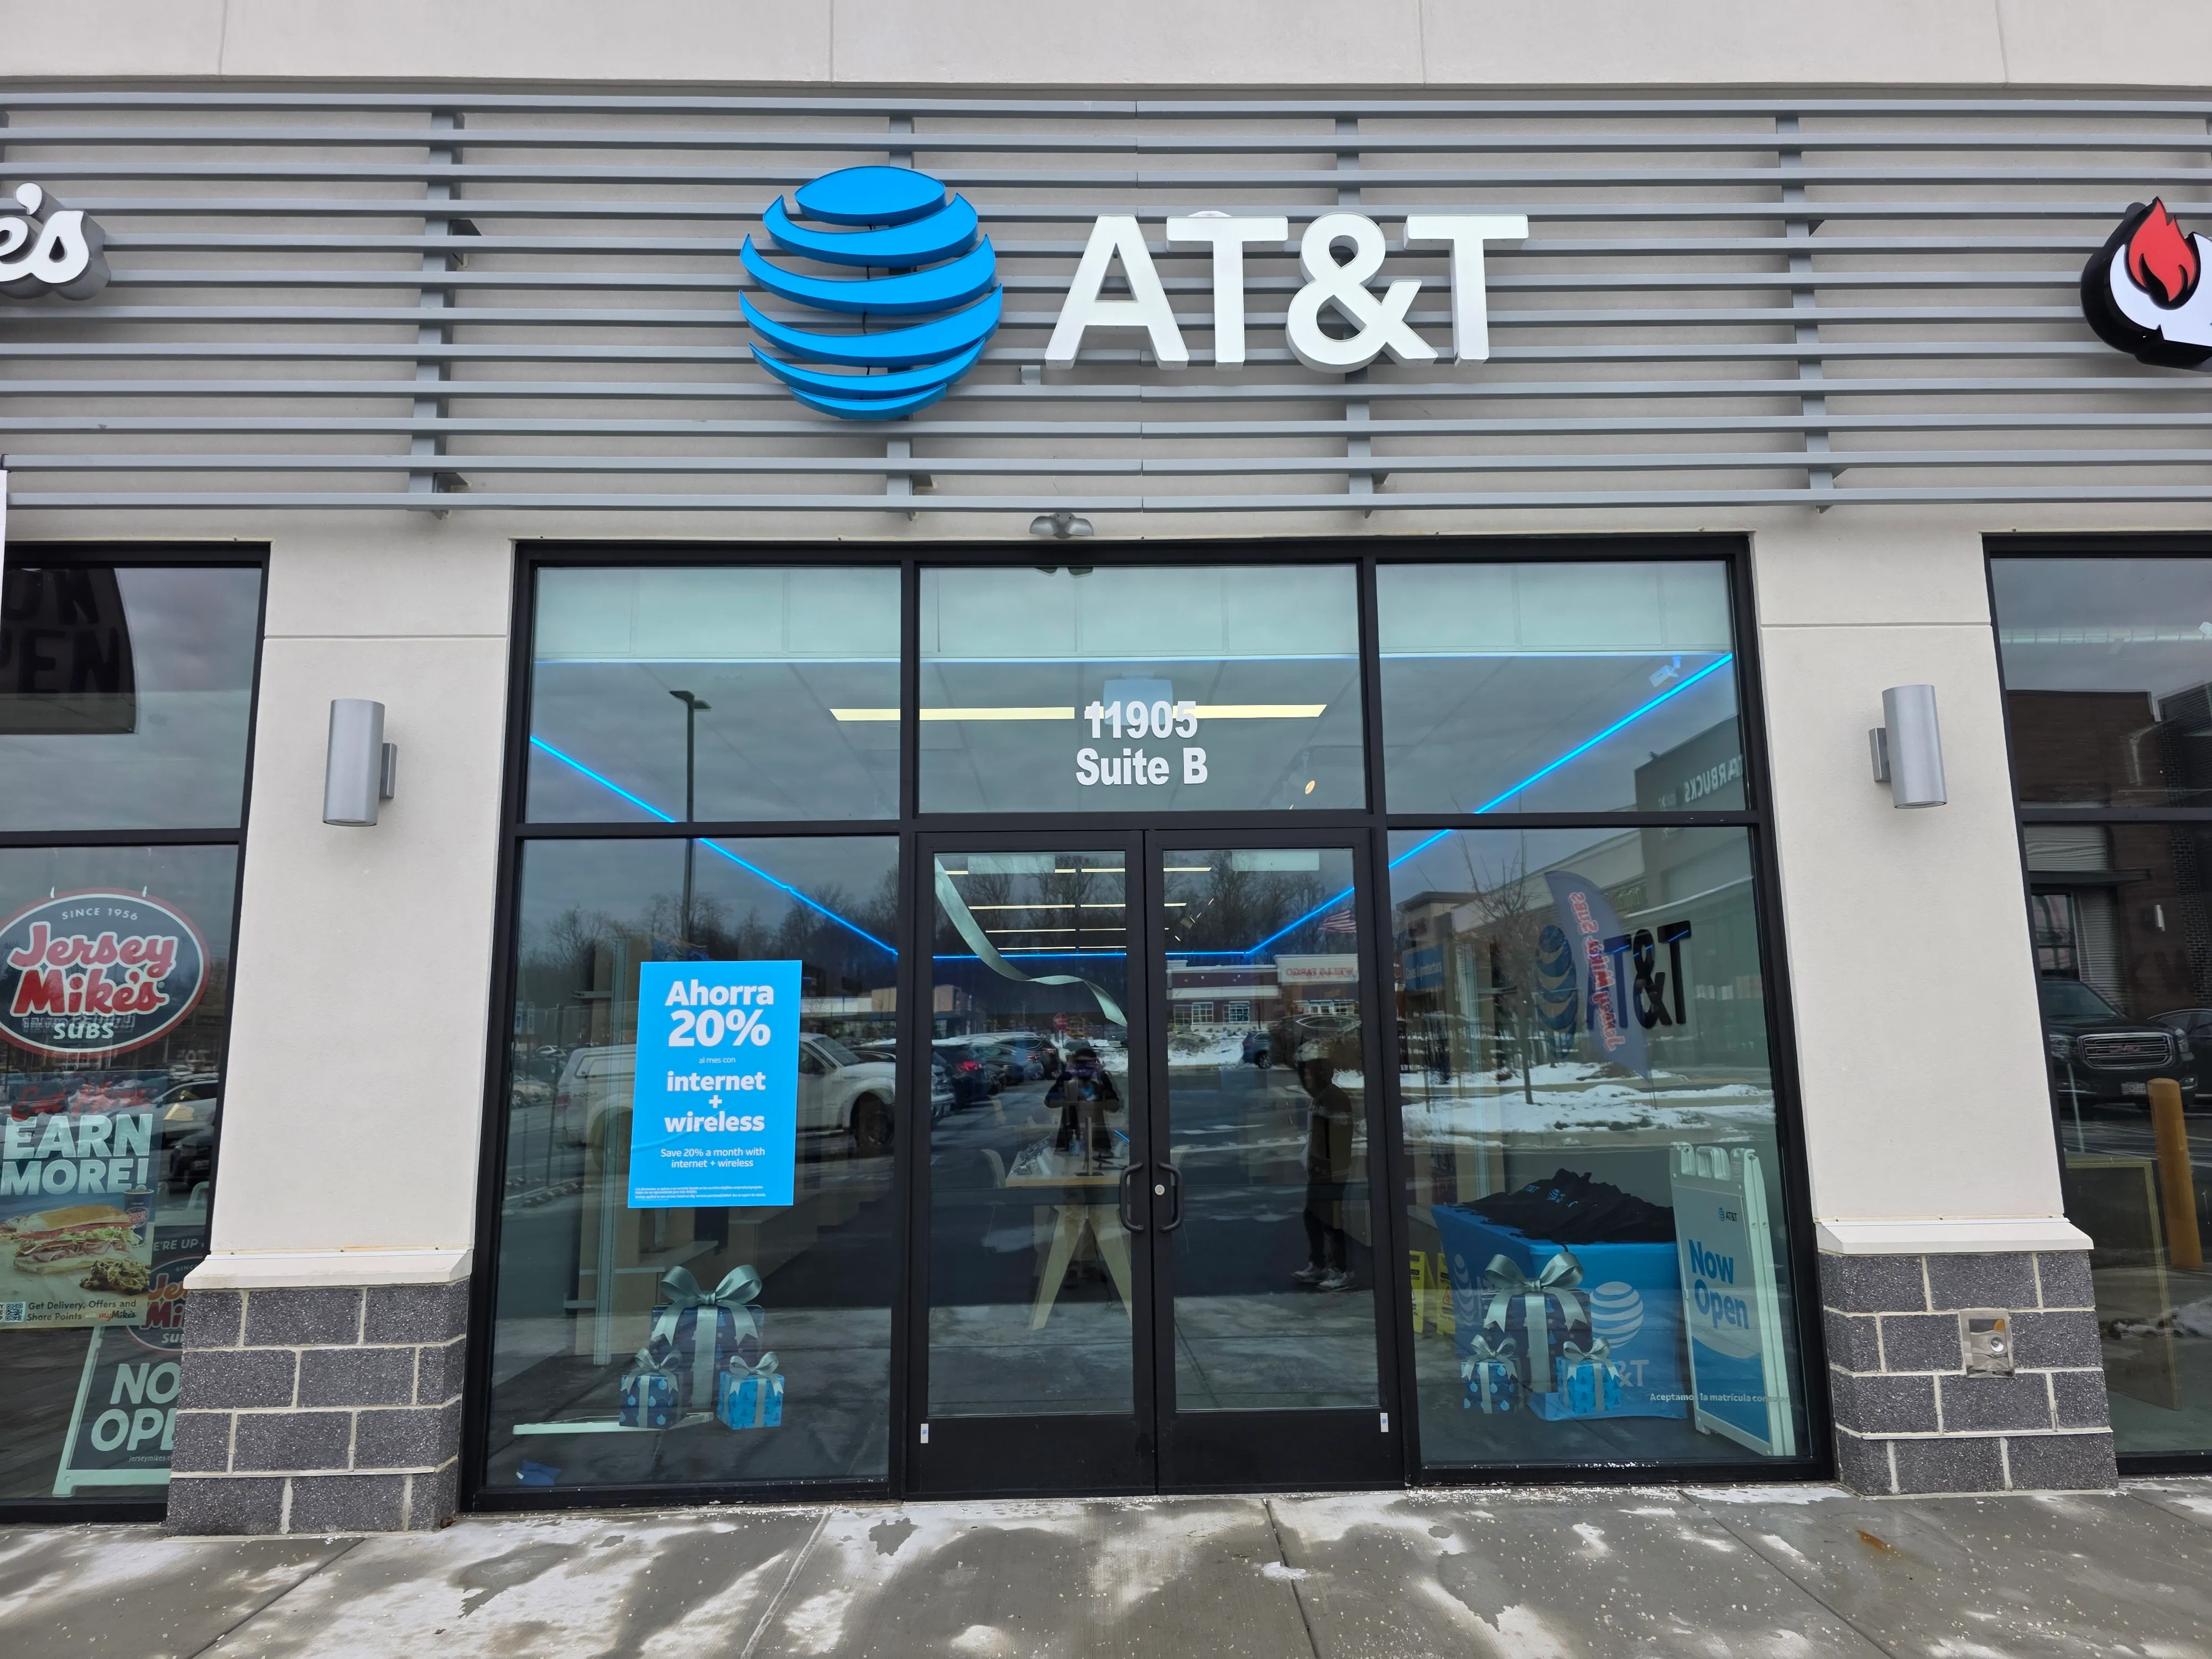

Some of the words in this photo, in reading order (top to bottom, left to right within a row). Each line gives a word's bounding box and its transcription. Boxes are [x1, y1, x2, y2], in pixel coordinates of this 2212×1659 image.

[1045, 211, 1528, 373] AT&T
[1084, 700, 1198, 739] 11905
[1076, 748, 1170, 786] Suite
[1183, 748, 1208, 784] B
[61, 907, 100, 920] SINCE
[107, 908, 138, 921] 1956
[7, 921, 178, 979] Jersey
[11, 969, 170, 1016] Mike's
[665, 979, 774, 1006] Ahorra
[53, 1022, 114, 1040] SUBS
[668, 1009, 771, 1047] 20%
[667, 1071, 766, 1092] internet
[664, 1111, 765, 1133] wireless
[3, 1114, 153, 1159] EARN
[660, 1149, 682, 1157] Save
[684, 1148, 703, 1157] 20%
[713, 1147, 744, 1157] month
[745, 1147, 765, 1156] with
[671, 1159, 707, 1168] internet
[717, 1159, 754, 1167] wireless
[0, 1158, 149, 1196] MORE!
[1725, 1211, 1738, 1222] AT&T
[181, 1239, 199, 1248] UP
[1688, 1239, 1734, 1285] Now
[47, 1302, 85, 1311] Delivery,
[88, 1300, 117, 1308] Offers
[119, 1299, 137, 1308] and
[1694, 1279, 1749, 1329] Open
[27, 1313, 52, 1321] Shore
[1650, 1393, 1698, 1403] Aceptamos
[1709, 1393, 1751, 1402] matrícula
